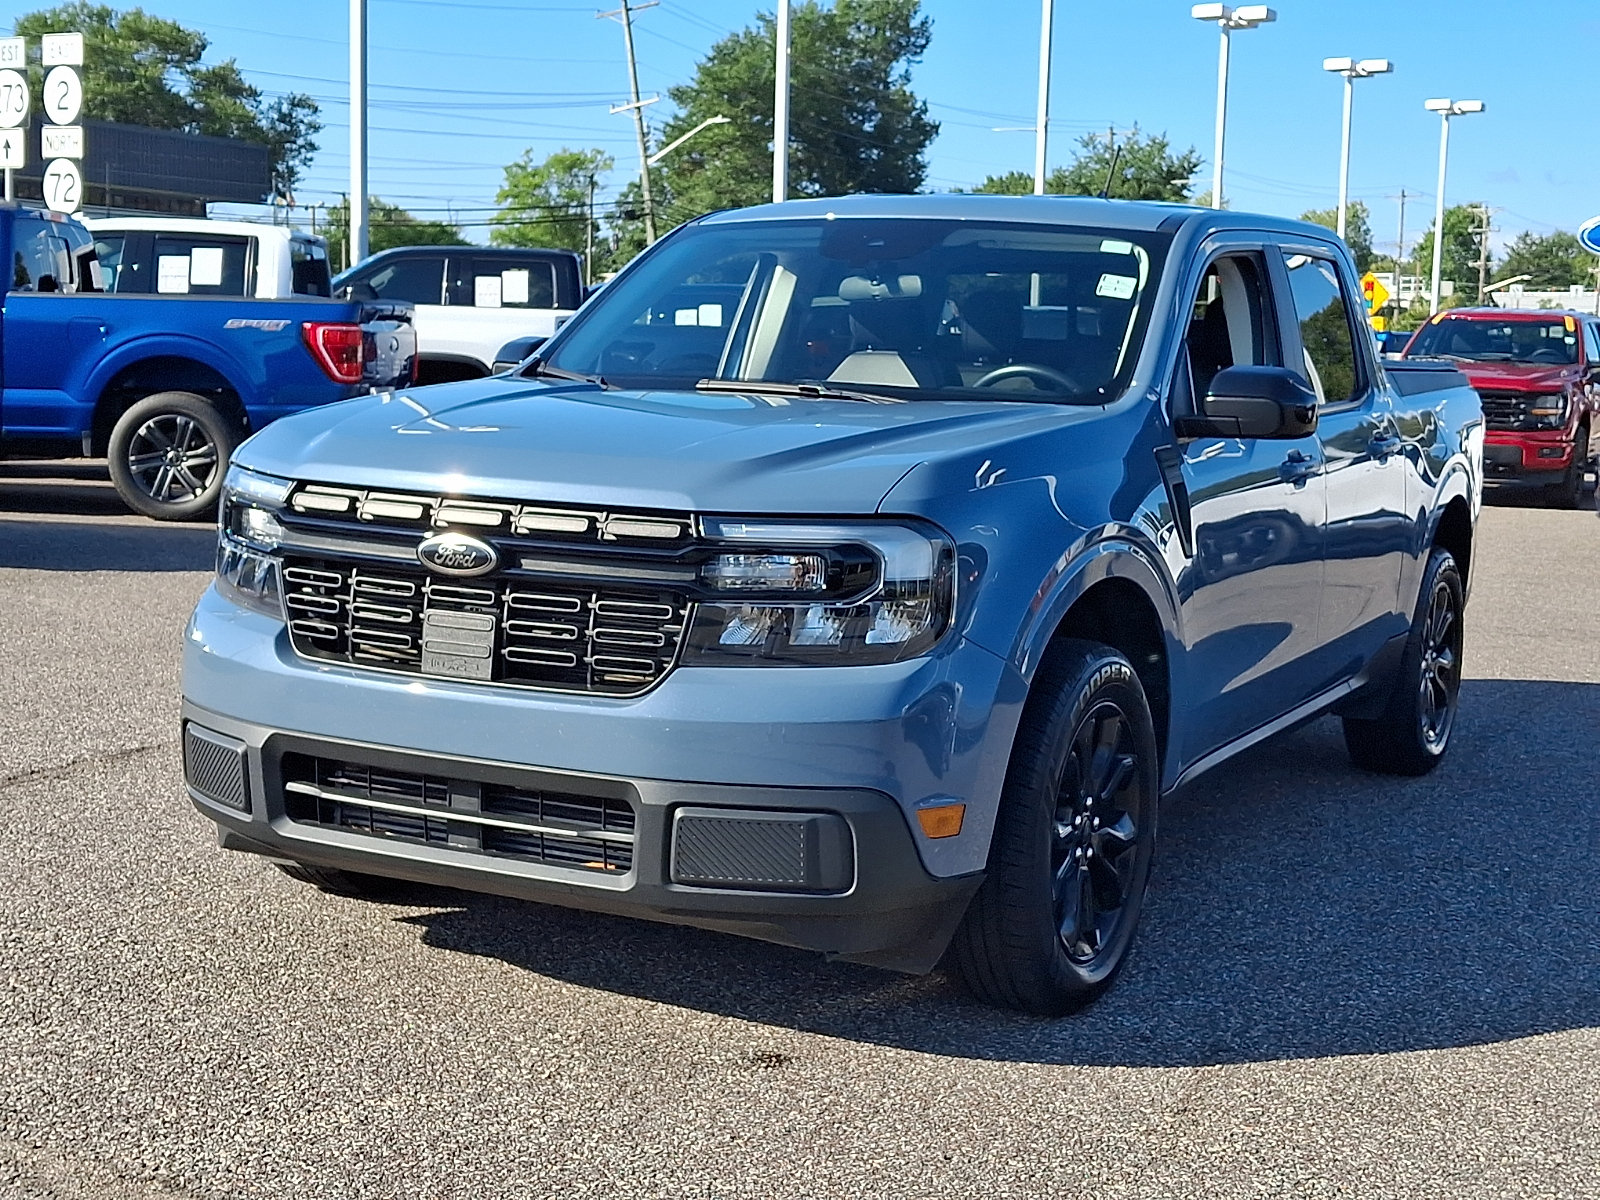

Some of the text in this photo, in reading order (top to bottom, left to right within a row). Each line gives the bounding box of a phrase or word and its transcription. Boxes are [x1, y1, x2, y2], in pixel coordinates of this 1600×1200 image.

[1, 44, 19, 61] EST
[0, 83, 25, 113] 73
[57, 80, 69, 111] 2
[45, 134, 79, 151] NORTH
[49, 172, 75, 203] 72
[434, 543, 477, 568] Ford
